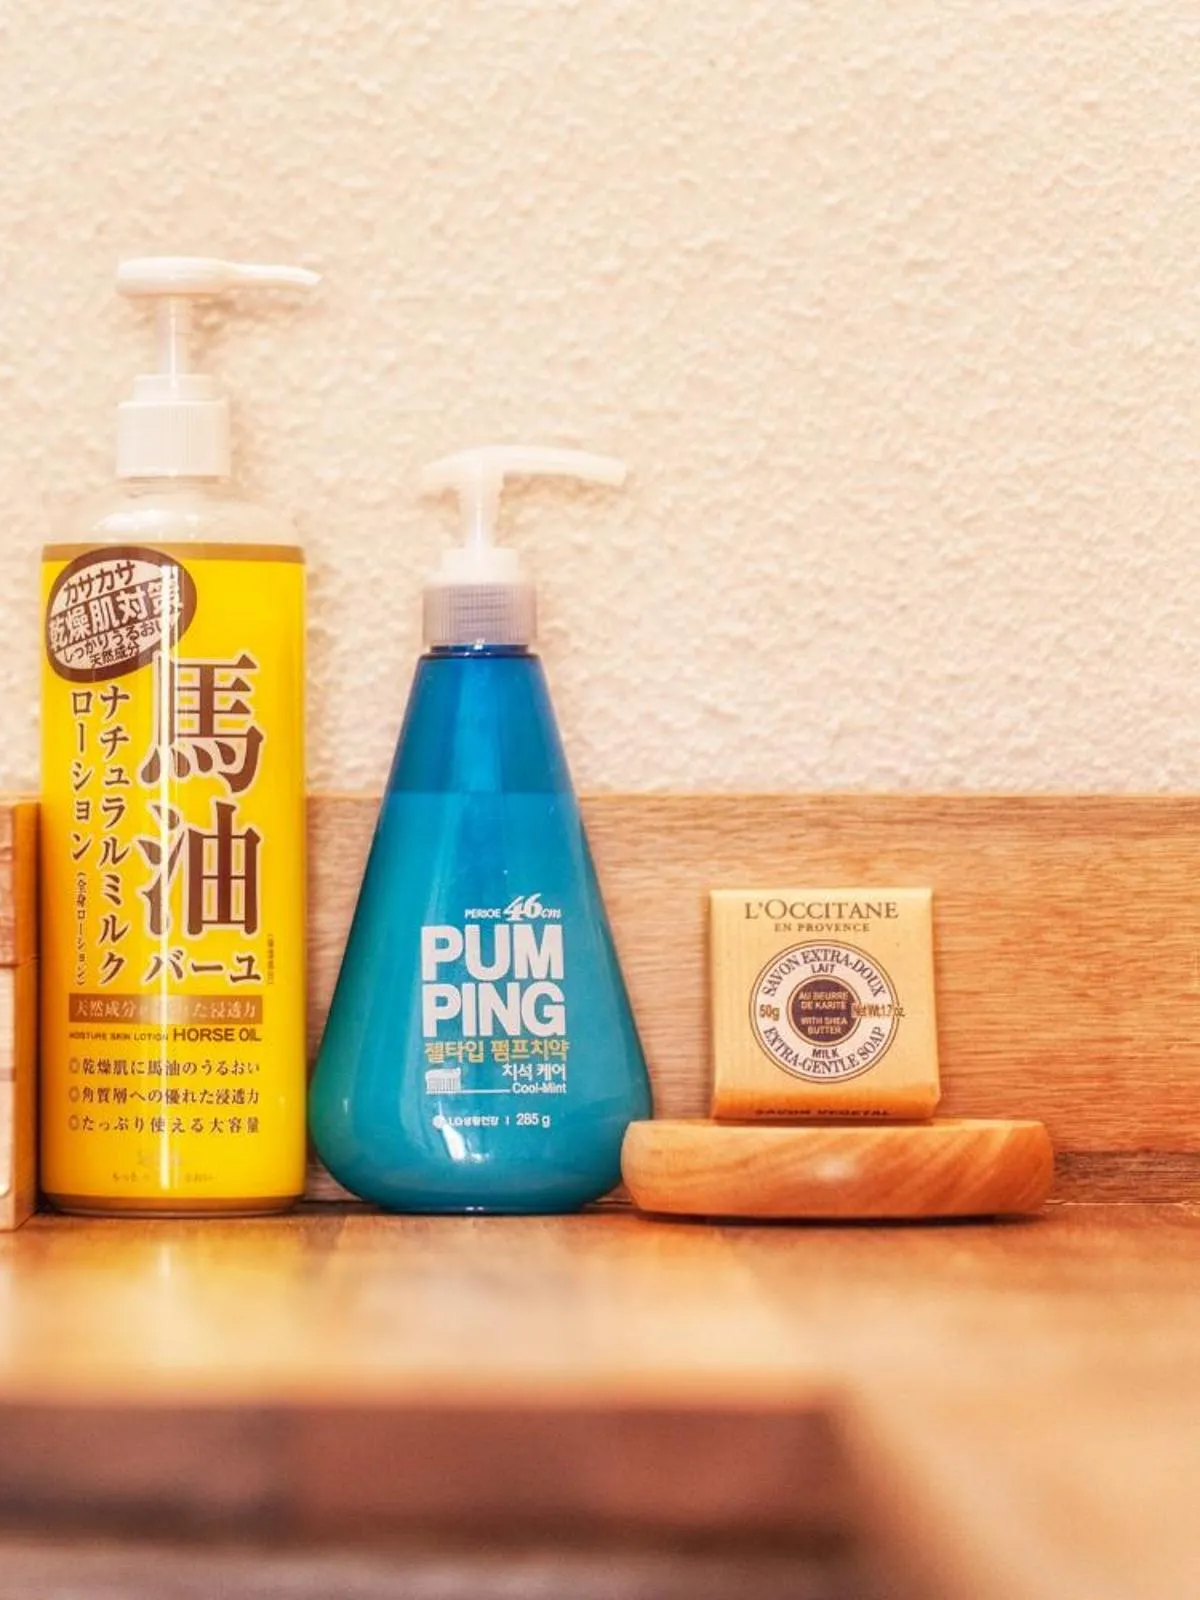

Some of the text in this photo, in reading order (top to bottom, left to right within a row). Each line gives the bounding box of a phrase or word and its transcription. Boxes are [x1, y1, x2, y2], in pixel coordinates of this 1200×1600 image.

[64, 560, 136, 607] カサカサ
[71, 691, 93, 861] ローション
[137, 653, 264, 936] 馬油
[99, 684, 130, 985] ナチュラルミルク
[745, 899, 899, 920] L'OCCITANE
[774, 923, 871, 933] EN PROVENCE
[146, 949, 262, 985] バーユ
[421, 924, 564, 981] PUM
[811, 963, 837, 974] LAIT
[762, 948, 887, 998] SAVON EXTRA-DOUX
[422, 982, 567, 1038] PING
[759, 1004, 780, 1021] 50g
[173, 1028, 235, 1042] HORSE
[239, 1028, 262, 1042] OIL
[763, 1026, 886, 1074] EXTRA-GENTLE SOAP
[812, 1048, 839, 1058] MILK
[502, 1063, 533, 1082] 치석
[516, 1113, 551, 1129] 285 g
